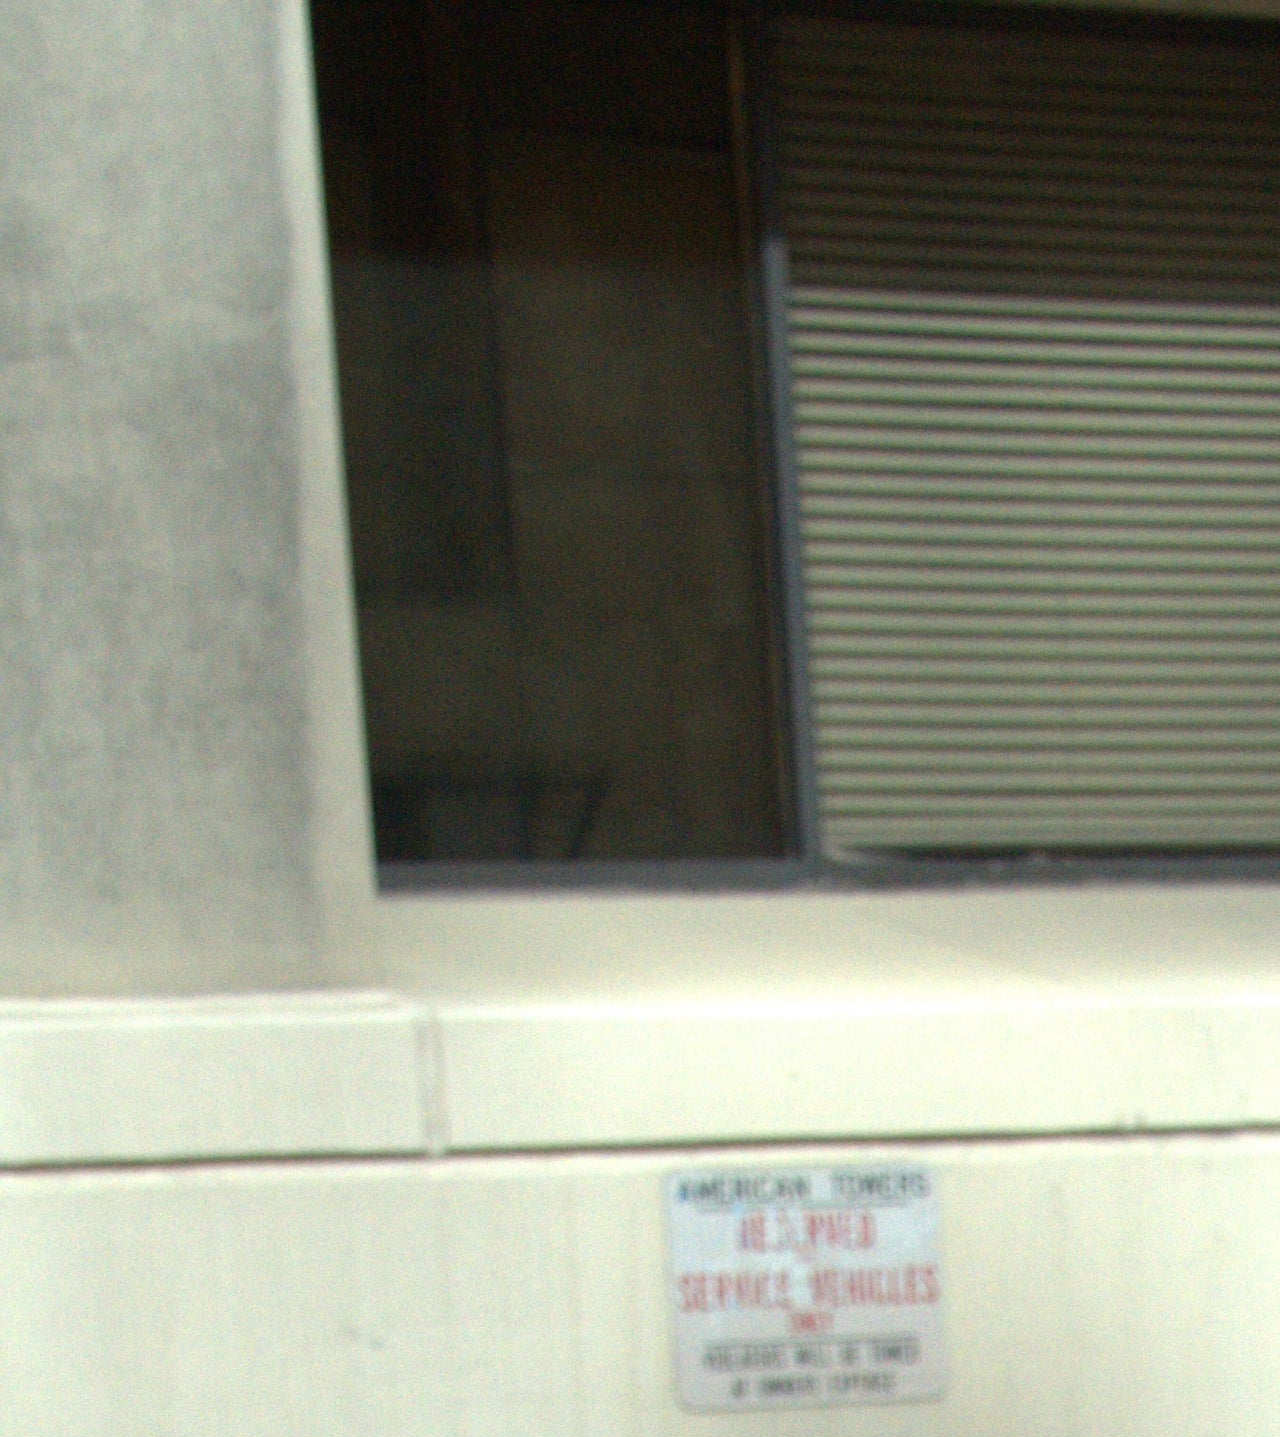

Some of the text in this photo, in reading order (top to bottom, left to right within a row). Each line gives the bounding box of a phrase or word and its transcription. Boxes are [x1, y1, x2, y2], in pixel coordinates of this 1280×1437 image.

[678, 1171, 931, 1204] AMERICAN TOWERS
[677, 1263, 941, 1312] SERVICE VEHICLES
